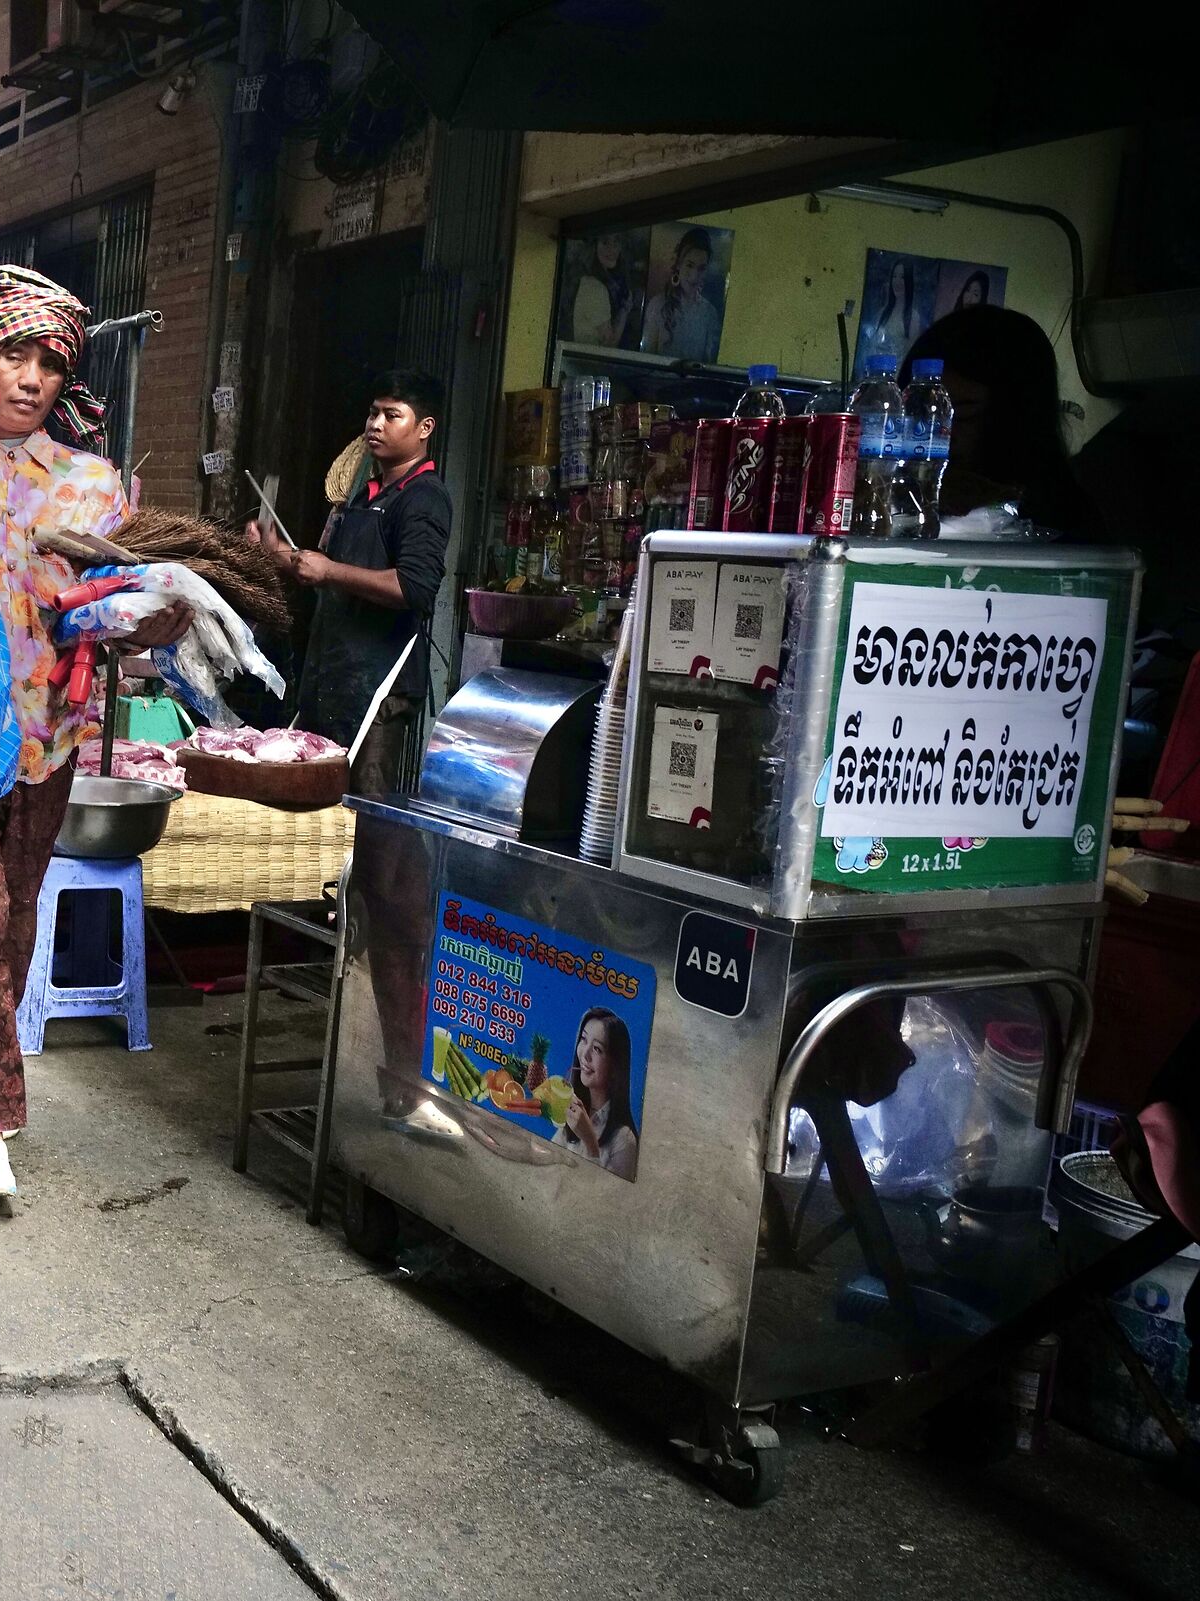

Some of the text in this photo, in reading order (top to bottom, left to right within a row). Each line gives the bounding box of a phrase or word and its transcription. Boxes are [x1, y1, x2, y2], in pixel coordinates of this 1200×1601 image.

[753, 575, 774, 585] PAY
[834, 710, 950, 804] ទឹកអំពៅ
[901, 855, 920, 873] 12
[933, 852, 962, 871] 1.5L
[440, 935, 523, 985] រសជាតិឆ្ងាញ់
[443, 899, 640, 1000] ទឹកអំពៅអនាម័យ
[685, 945, 740, 983] ABA
[435, 979, 526, 1028] 088 675 6699
[438, 960, 532, 1010] 012 844 316
[433, 997, 516, 1044] 098 210 533
